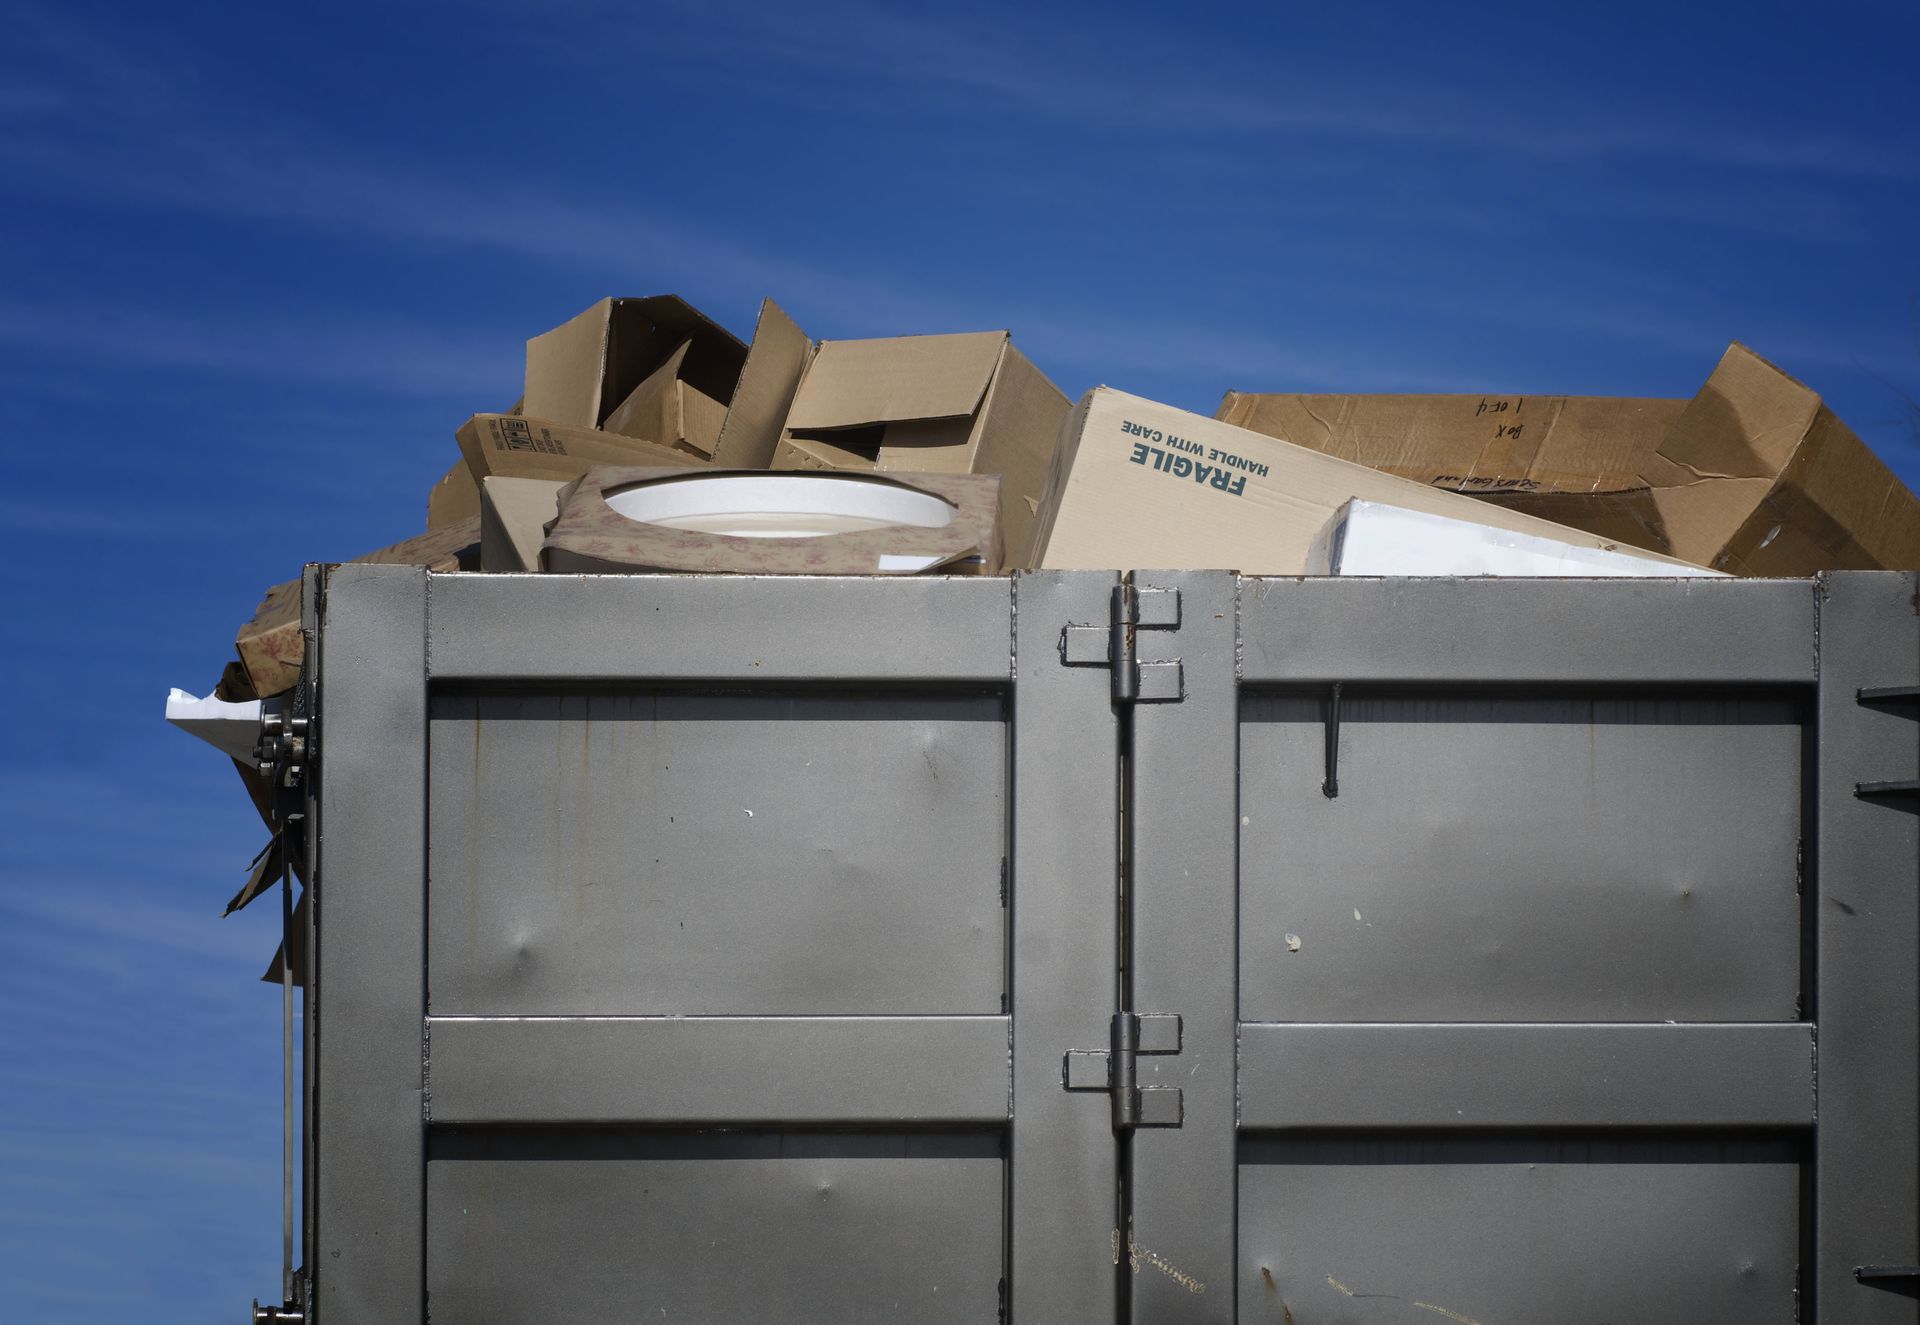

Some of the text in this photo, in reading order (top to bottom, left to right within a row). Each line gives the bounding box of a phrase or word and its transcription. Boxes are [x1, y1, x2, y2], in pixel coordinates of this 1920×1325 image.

[1516, 397, 1523, 414] 1
[1120, 420, 1270, 477] HANDLE WITH CARE
[1129, 442, 1247, 497] FRAGILE
